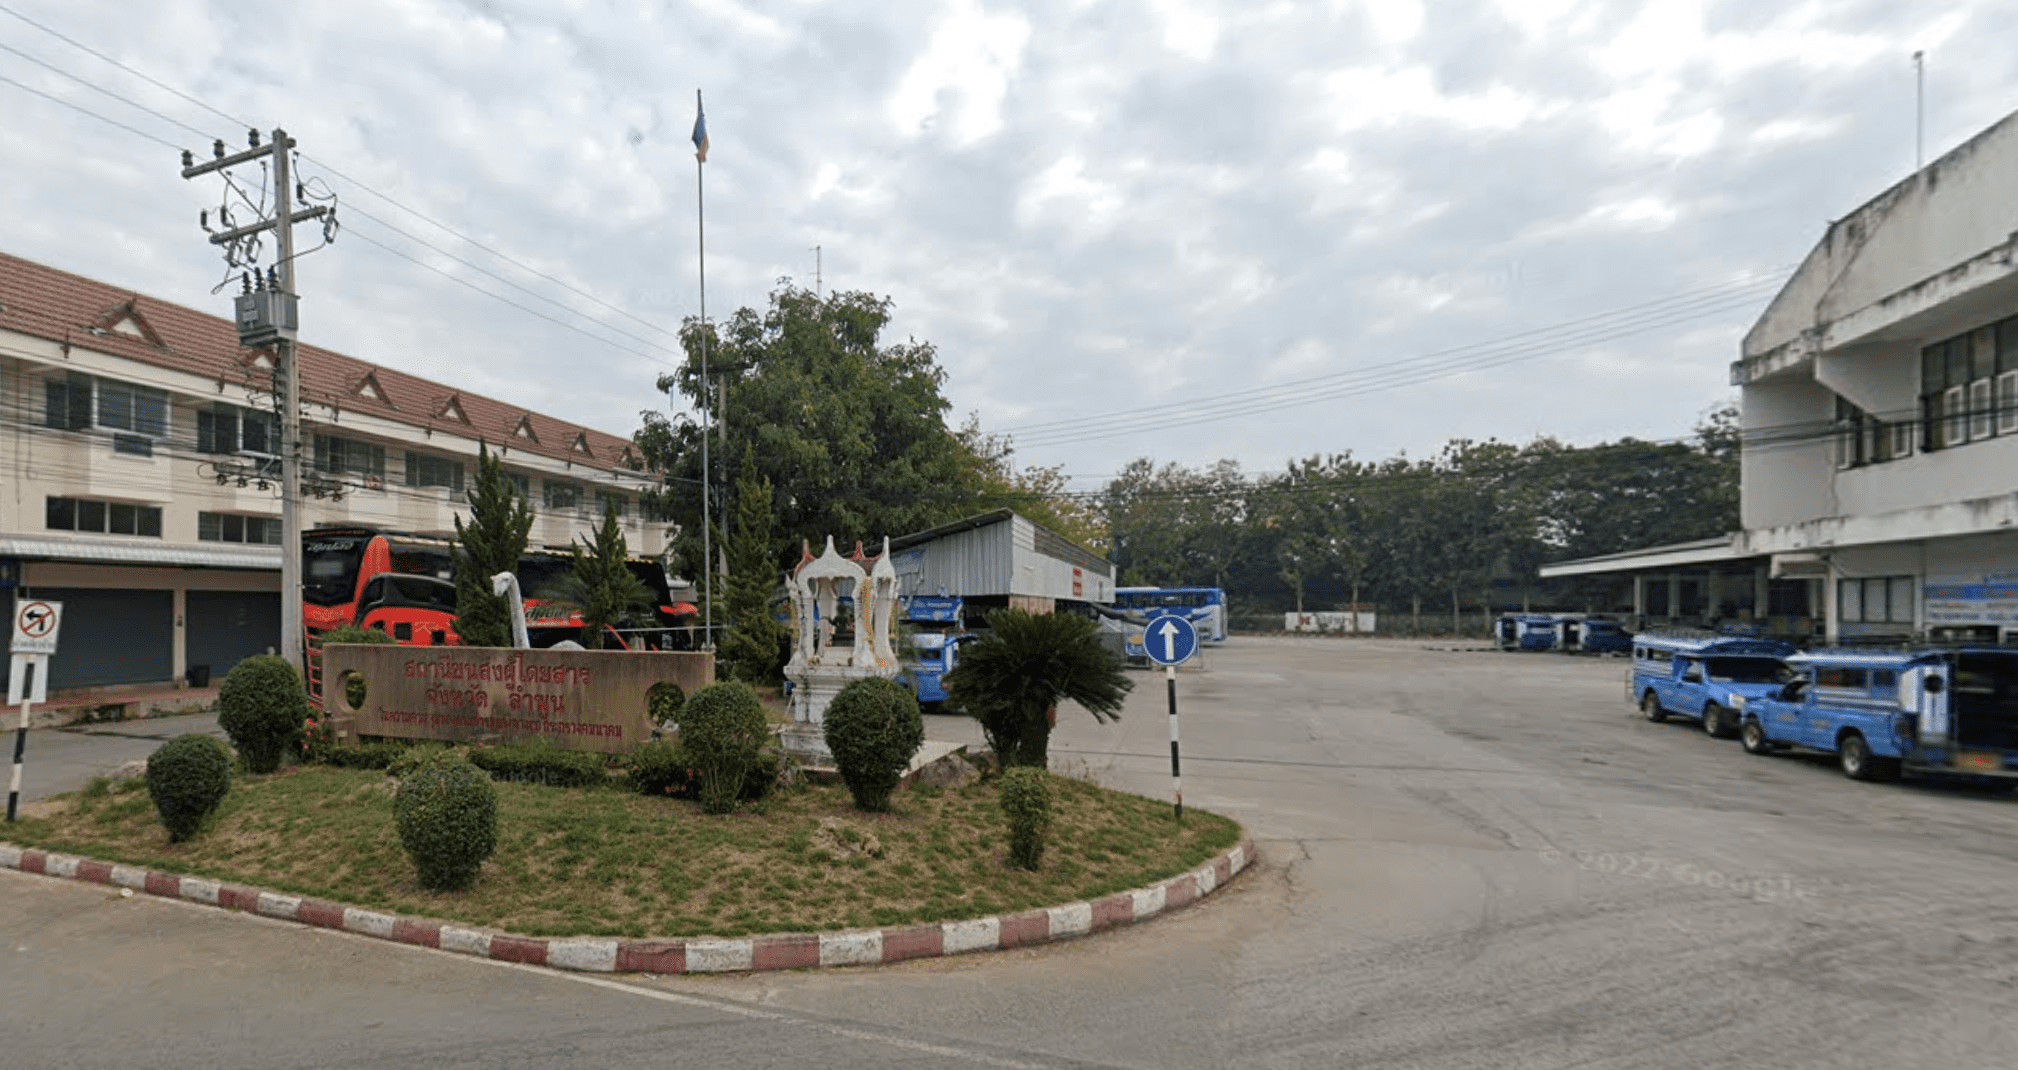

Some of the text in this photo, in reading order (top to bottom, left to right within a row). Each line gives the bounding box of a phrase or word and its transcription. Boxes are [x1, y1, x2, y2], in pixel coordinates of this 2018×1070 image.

[404, 651, 591, 690] สถานีขนส่งผู้โดยสาร
[425, 682, 565, 719] จังหวัด ลำพูน
